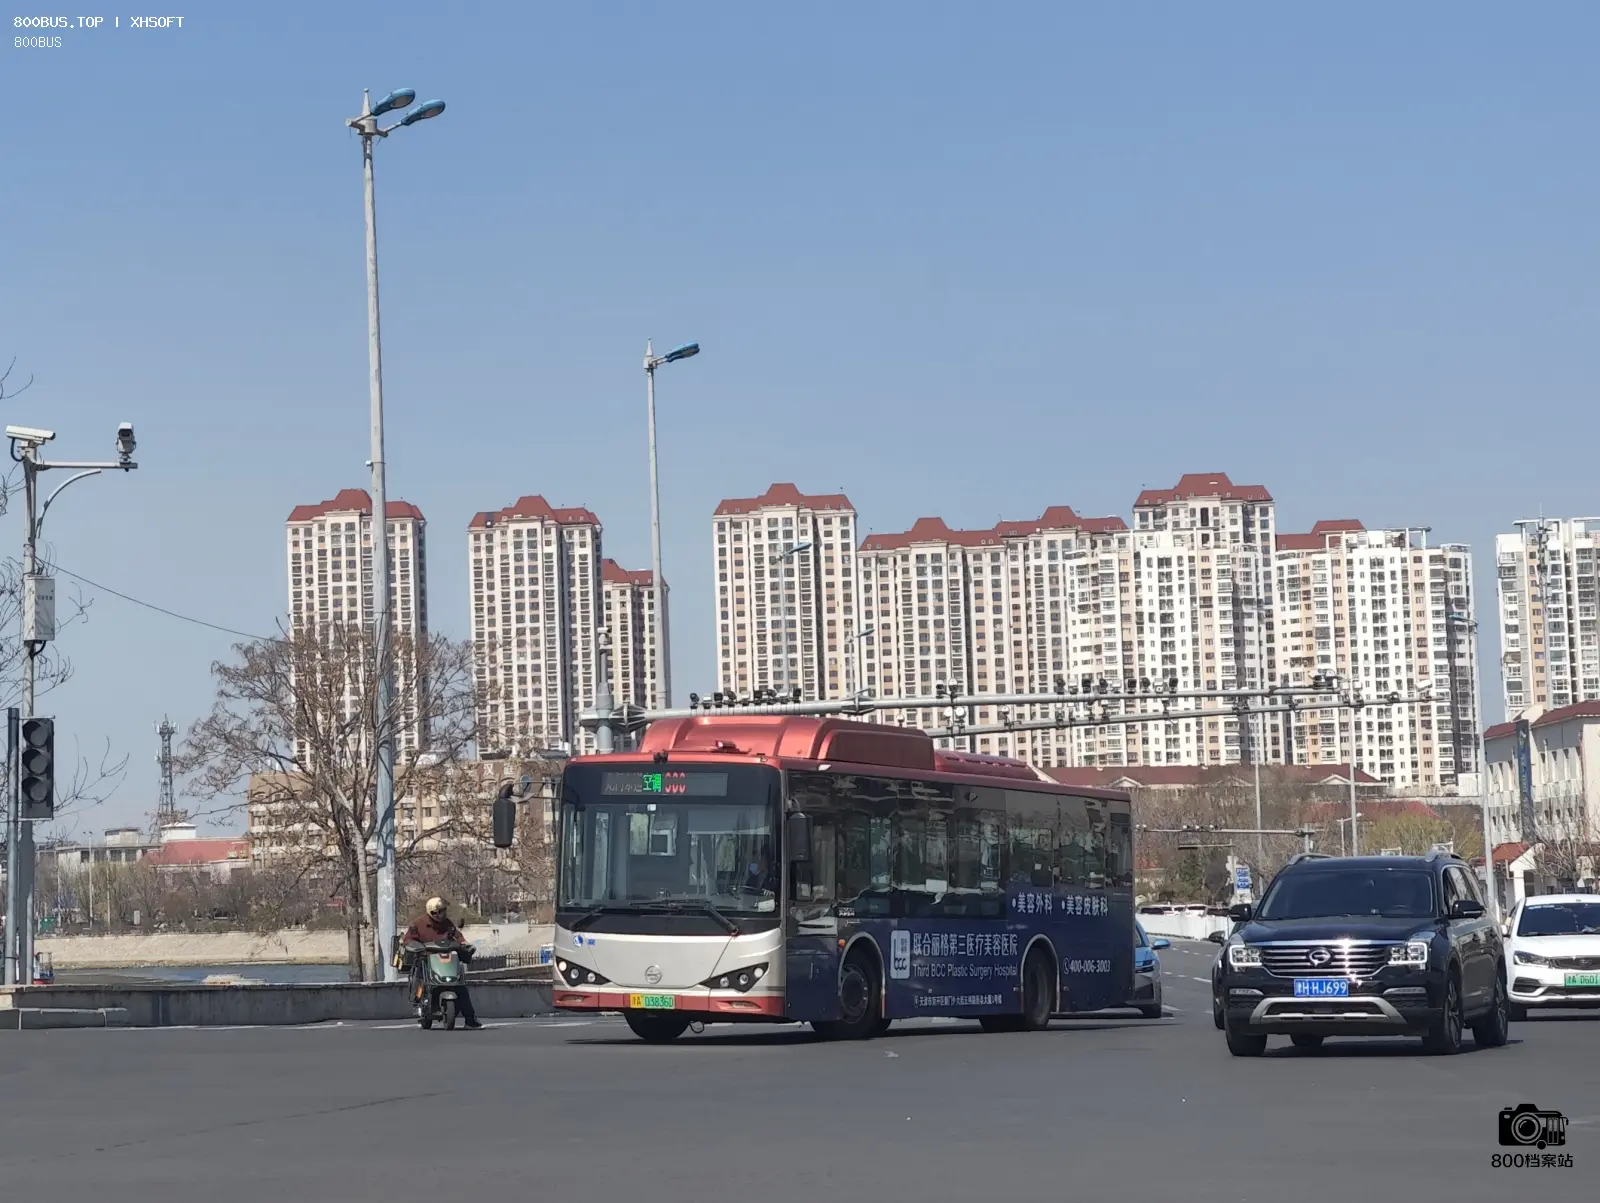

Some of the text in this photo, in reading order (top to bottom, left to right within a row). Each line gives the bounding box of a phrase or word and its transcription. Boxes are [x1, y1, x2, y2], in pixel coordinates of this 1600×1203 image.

[1017, 892, 1053, 915] 美容外科
[912, 932, 1019, 957] 联合丽格第三医疗美容医院
[912, 962, 1018, 980] Third BCC Plastic Surgery Hospital
